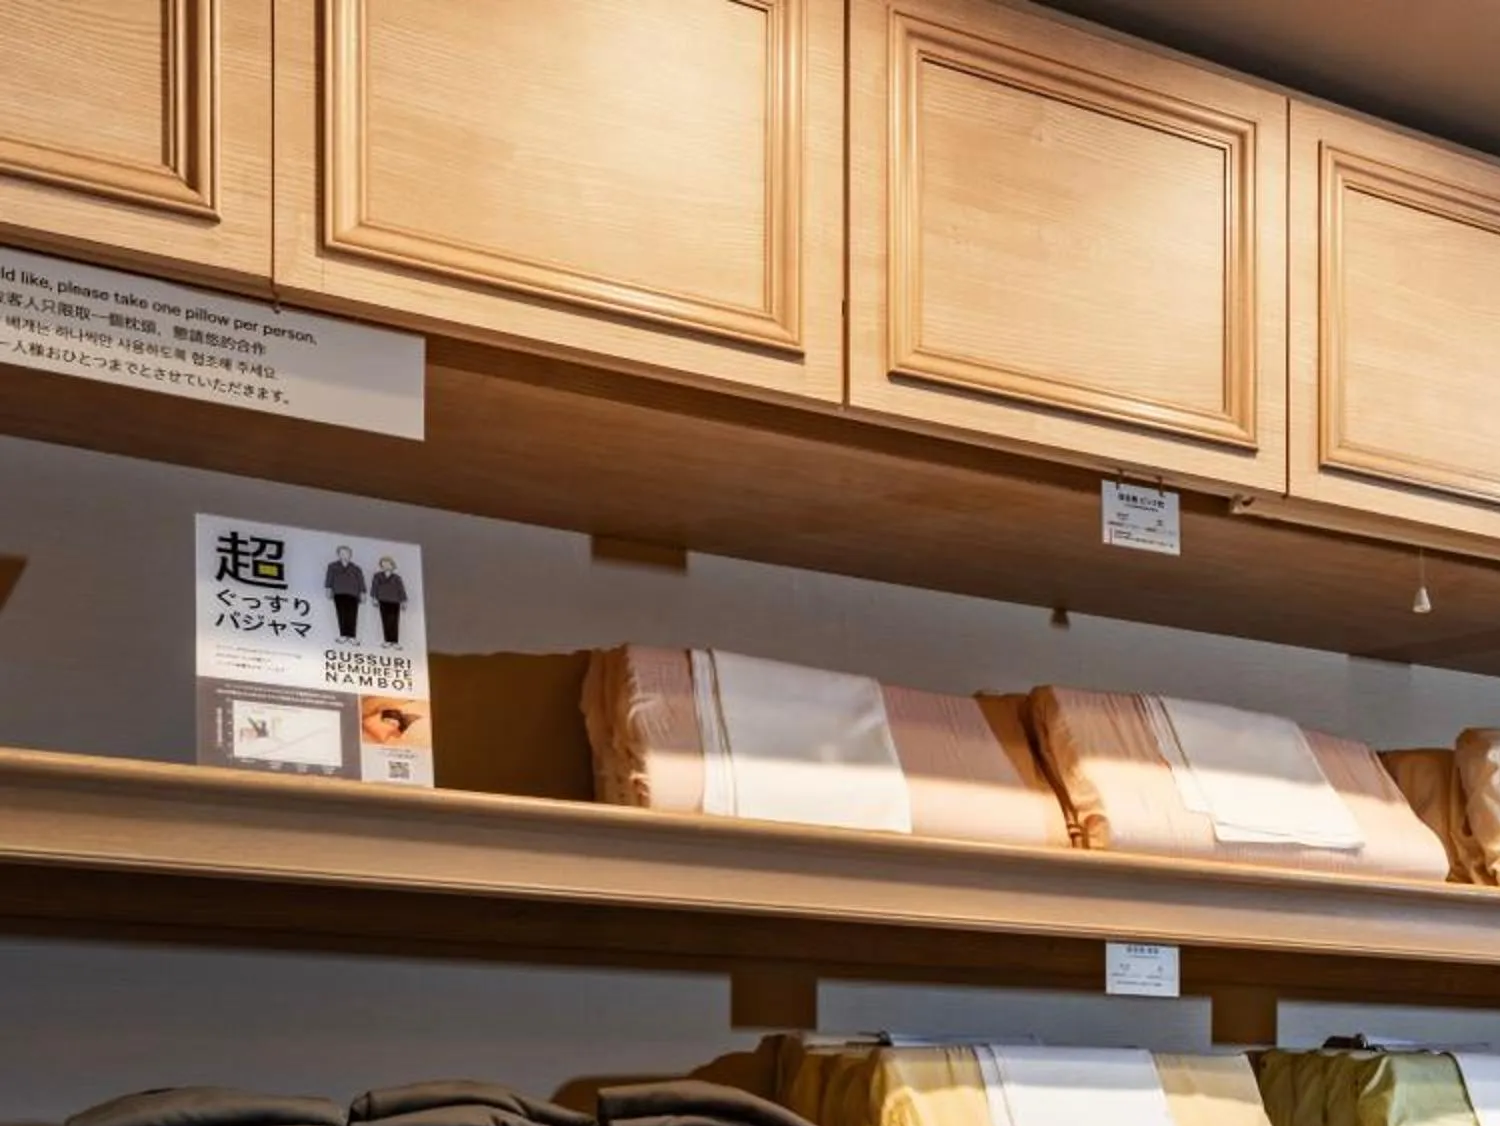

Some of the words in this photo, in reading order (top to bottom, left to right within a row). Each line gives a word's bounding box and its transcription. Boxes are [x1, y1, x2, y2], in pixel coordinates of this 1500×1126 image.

[21, 271, 53, 291] like,
[57, 280, 109, 302] please
[114, 292, 148, 309] take
[152, 301, 181, 316] one
[185, 307, 230, 326] pillow
[234, 317, 258, 332] per
[215, 531, 288, 590] 超
[216, 588, 311, 617] ぐっすり
[325, 649, 412, 669] GUSSURI
[325, 661, 412, 681] NEMURETE
